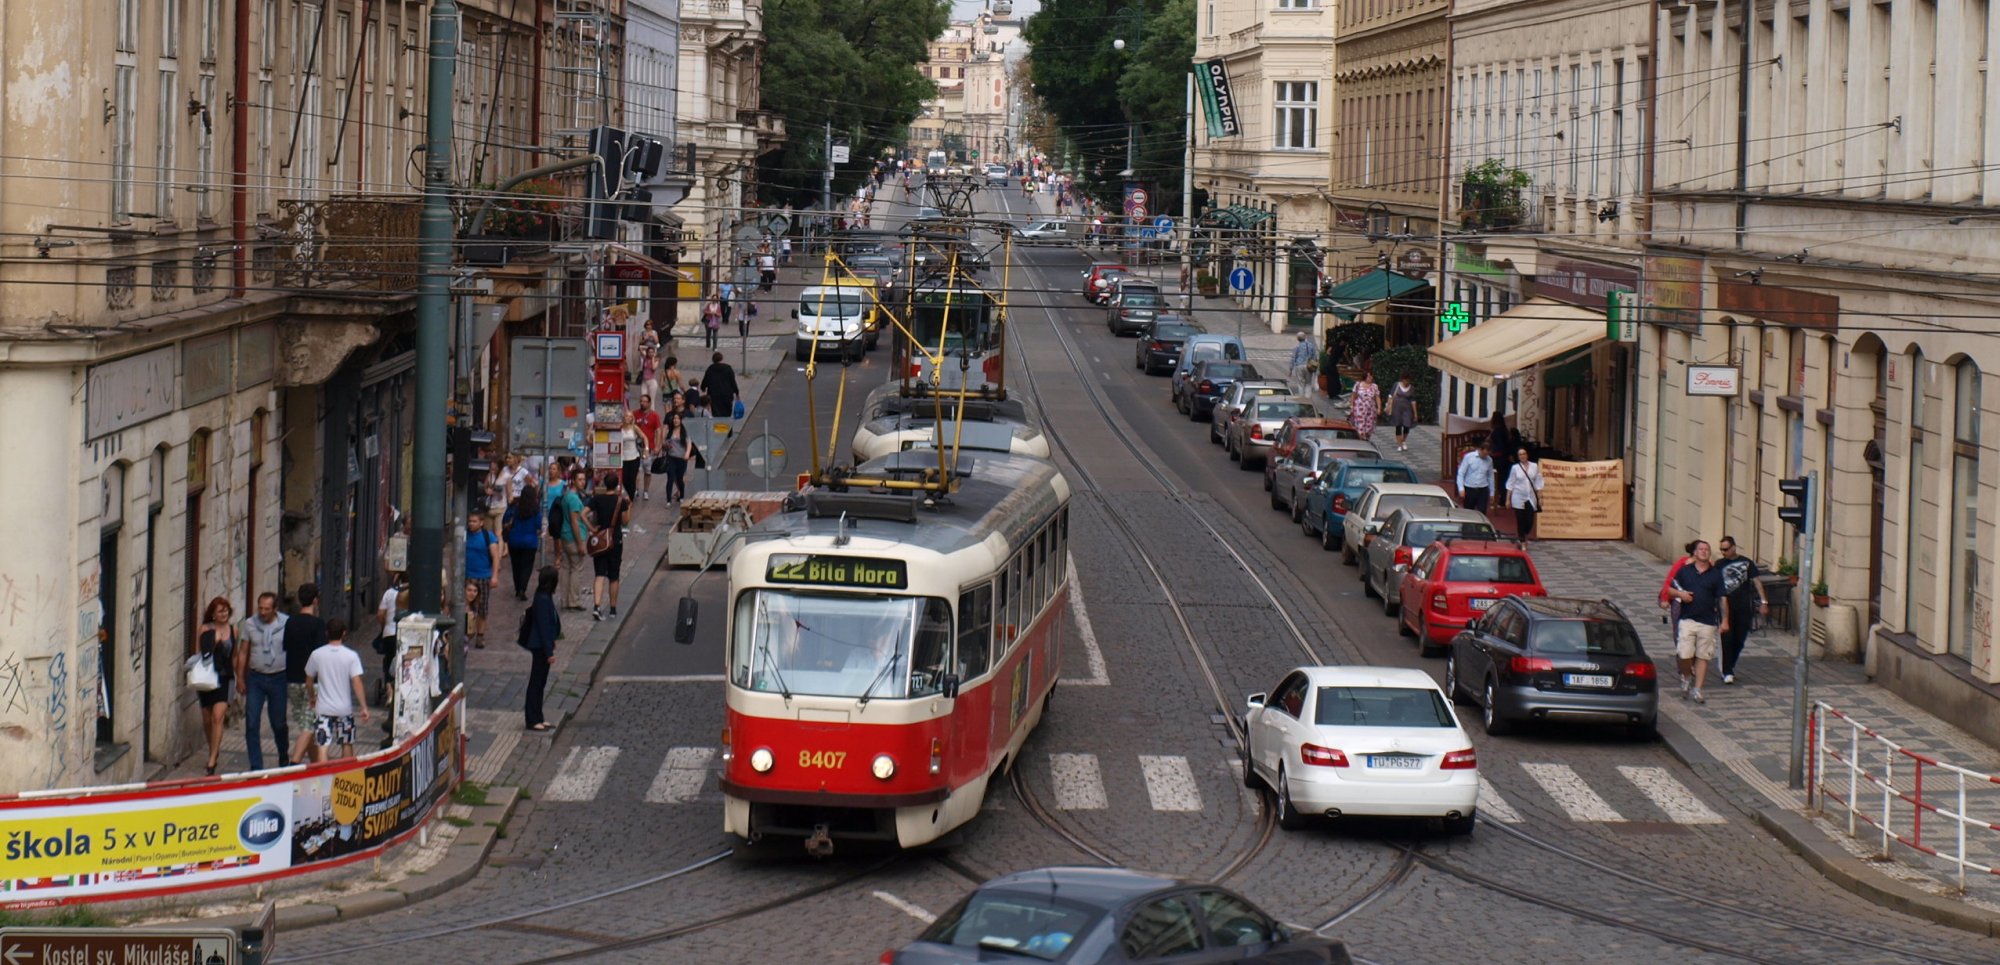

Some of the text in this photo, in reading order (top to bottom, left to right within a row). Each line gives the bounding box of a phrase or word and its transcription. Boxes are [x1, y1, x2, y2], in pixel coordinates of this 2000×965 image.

[772, 561, 897, 585] 22 Bílá Hora
[798, 749, 847, 769] 8407
[334, 777, 363, 796] ROZVOZ
[366, 767, 402, 803] RAUTY
[335, 792, 357, 809] JÍDLA
[364, 805, 400, 839] SVATBY
[6, 822, 220, 860] škola 5 x v Praze
[42, 943, 189, 965] Kostel sv. Mikuláše
